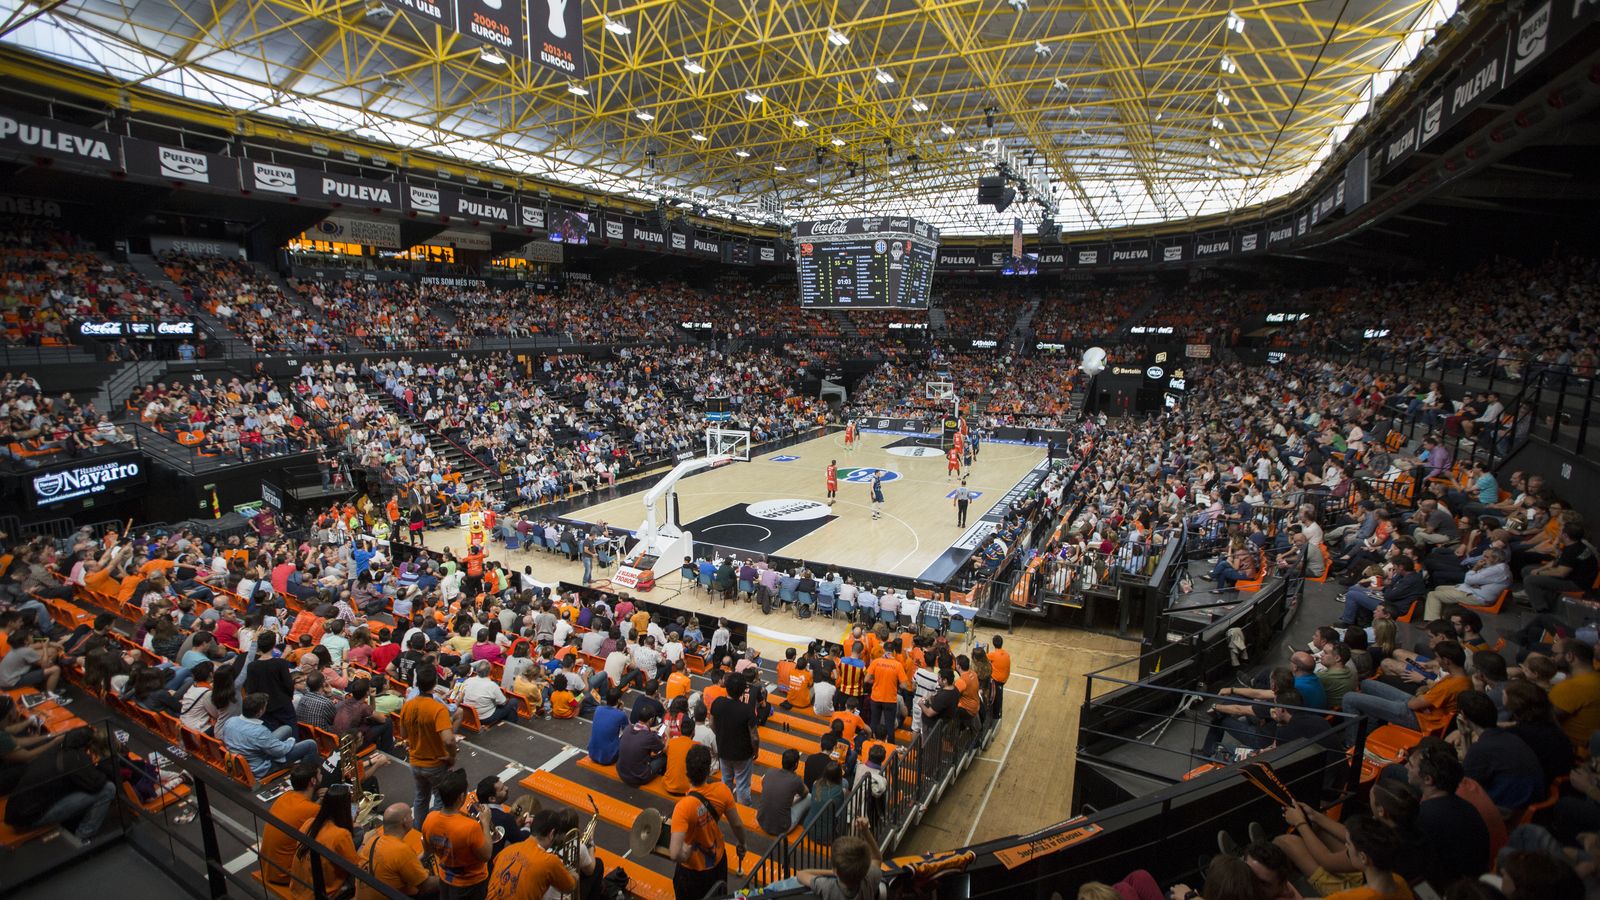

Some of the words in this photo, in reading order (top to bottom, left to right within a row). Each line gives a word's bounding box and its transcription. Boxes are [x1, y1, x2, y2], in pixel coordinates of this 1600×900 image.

[417, 0, 441, 19] ULEB
[473, 12, 510, 36] 2009-10
[1519, 9, 1548, 42] PULEVA
[471, 22, 513, 47] EUROCUP
[543, 42, 572, 62] 2013-14
[540, 50, 576, 72] EUROCUP
[1452, 58, 1497, 115] PULEVA
[0, 116, 112, 161] PULEVA
[1387, 127, 1414, 164] PULEVA
[163, 151, 205, 167] PULEVA
[256, 166, 293, 180] PULEVA
[322, 178, 392, 203] PULEVA
[411, 189, 439, 201] PULEVA
[458, 199, 508, 220] PULEVA
[523, 208, 544, 219] PULEVA
[607, 223, 623, 231] PULEVA
[1269, 227, 1292, 243] PULEVA
[633, 228, 663, 243] PULEVA
[172, 240, 221, 254] SEMPRE
[694, 239, 719, 253] PULEVA
[1197, 241, 1230, 255] PULEVA
[940, 255, 976, 265] PULEVA
[1113, 249, 1148, 260] PULEVA
[421, 276, 440, 286] JUNTS
[440, 277, 454, 286] SOM
[63, 462, 139, 491] Navarro
